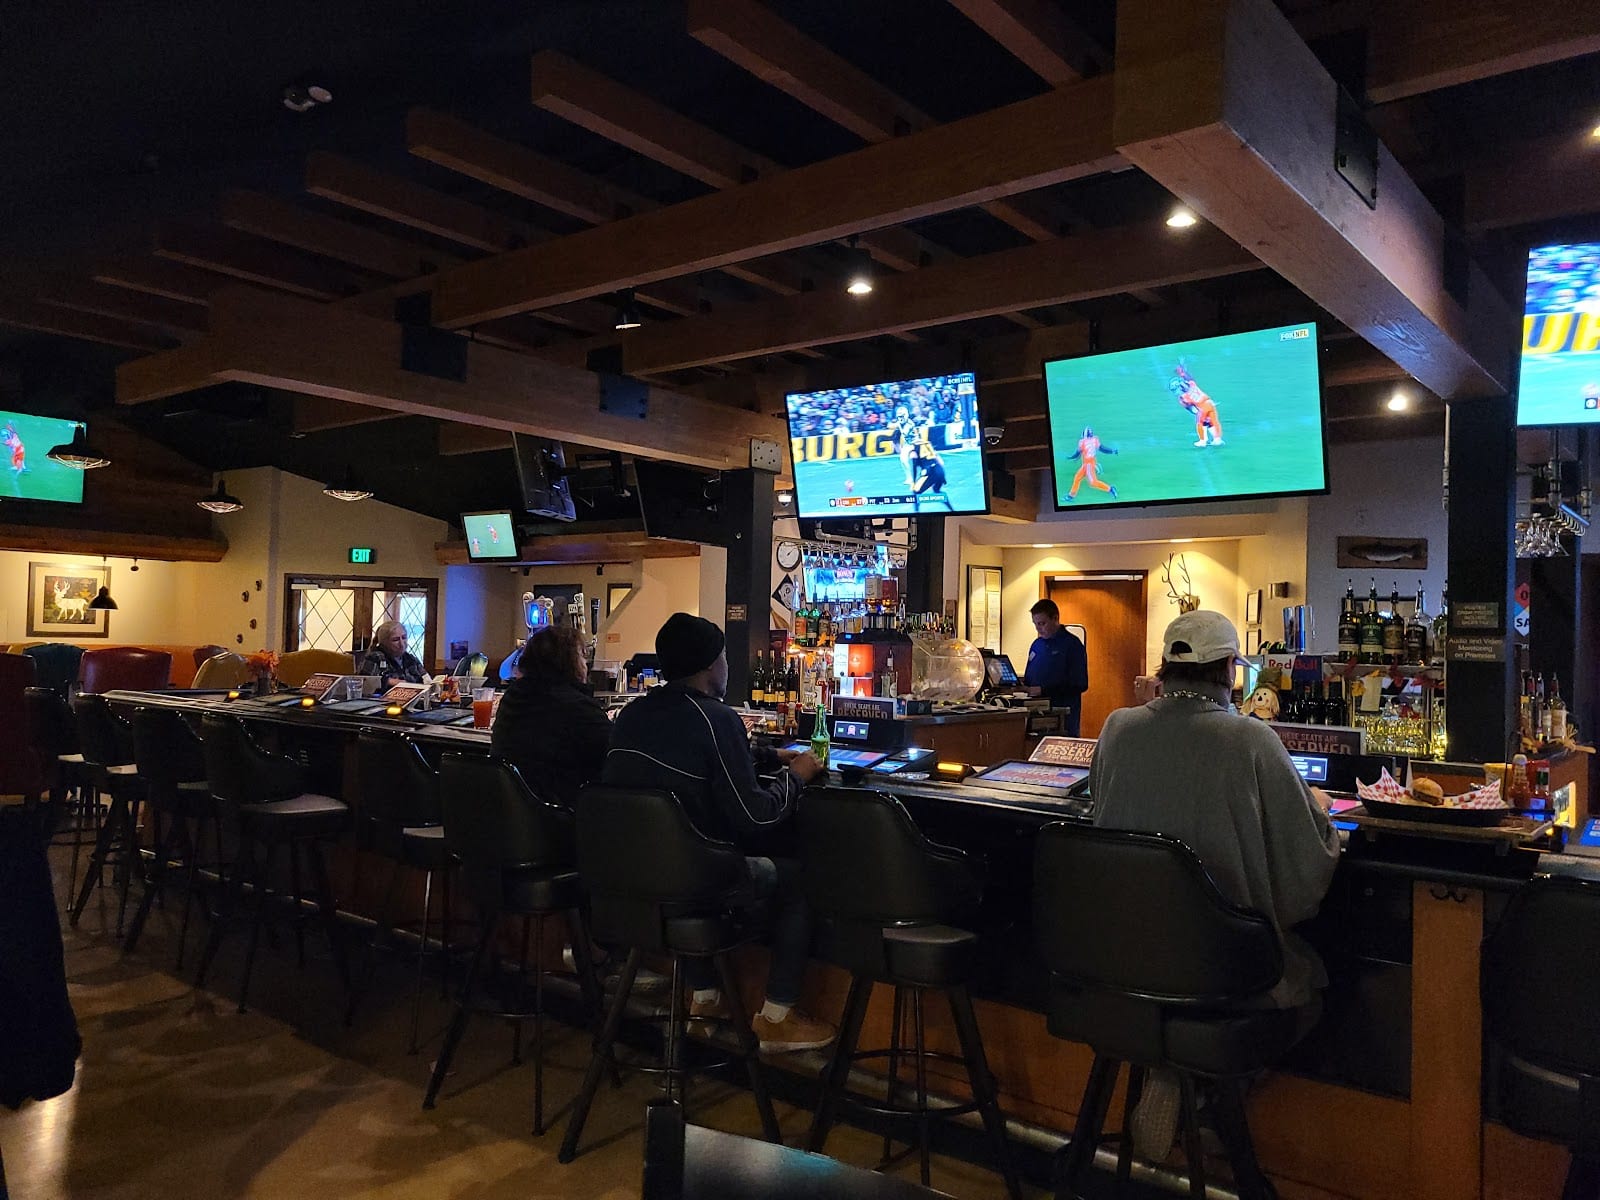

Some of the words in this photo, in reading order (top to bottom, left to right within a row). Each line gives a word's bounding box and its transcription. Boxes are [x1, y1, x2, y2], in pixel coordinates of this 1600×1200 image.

[352, 548, 371, 563] EXIT
[1268, 658, 1292, 670] Red
[1295, 659, 1318, 669] Bull
[1044, 745, 1095, 758] RESERV
[1285, 740, 1352, 755] SERVED
